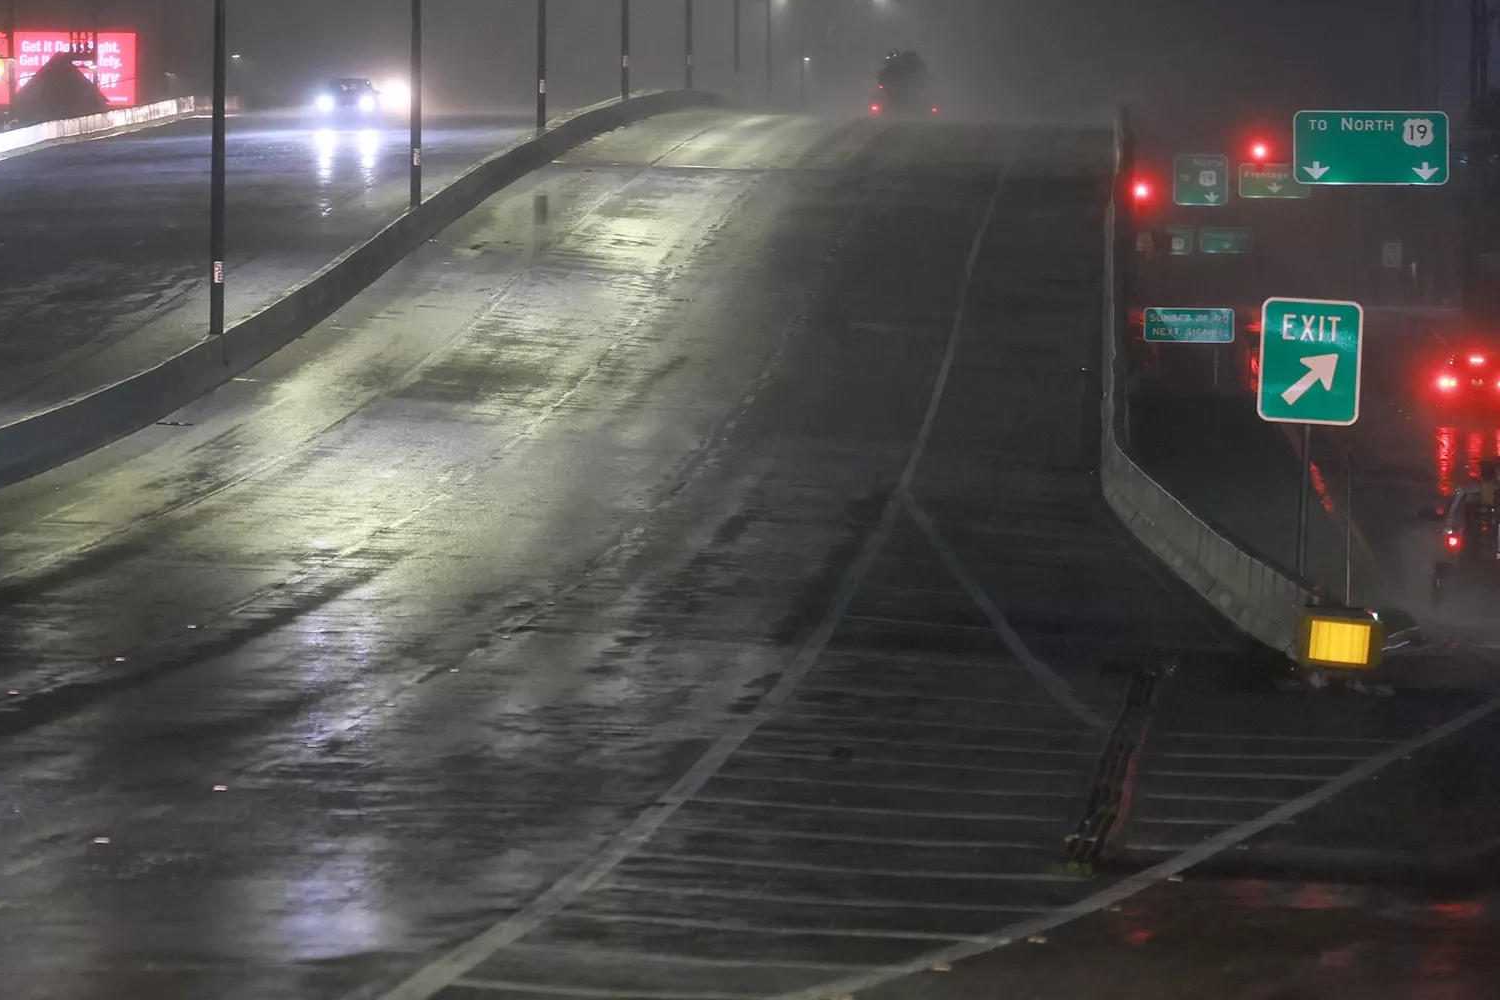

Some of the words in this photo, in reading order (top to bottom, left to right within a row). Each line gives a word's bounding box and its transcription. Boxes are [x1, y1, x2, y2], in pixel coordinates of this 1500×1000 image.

[21, 40, 41, 53] Get
[19, 54, 40, 67] Get
[1308, 119, 1328, 132] TO
[1341, 117, 1395, 132] NORTH
[1409, 124, 1429, 141] 19
[1202, 173, 1214, 184] 19
[1243, 170, 1289, 181] Frontage
[1149, 313, 1192, 322] SUNSET
[1152, 327, 1180, 336] NEXT
[1282, 313, 1342, 342] EXIT
